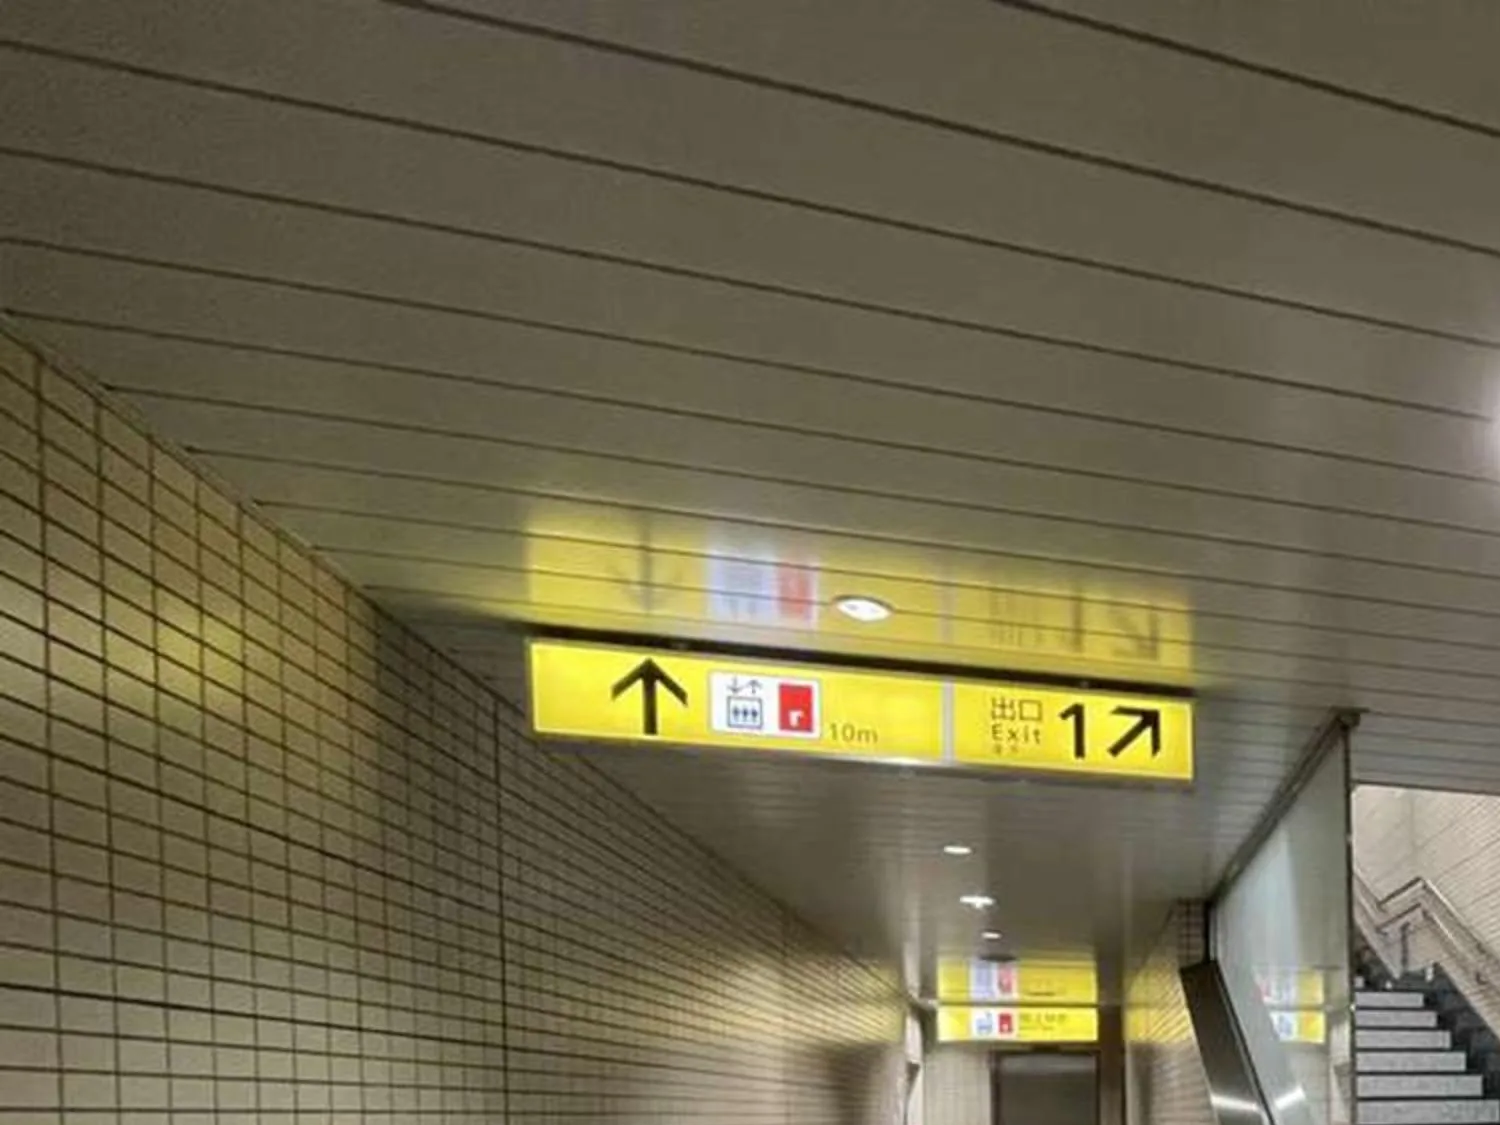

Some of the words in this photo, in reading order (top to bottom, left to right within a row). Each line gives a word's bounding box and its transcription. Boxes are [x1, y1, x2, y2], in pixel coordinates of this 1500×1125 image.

[991, 697, 1042, 721] 出口
[830, 723, 878, 744] 10m
[991, 723, 1041, 744] Exit
[1058, 703, 1085, 759] 1
